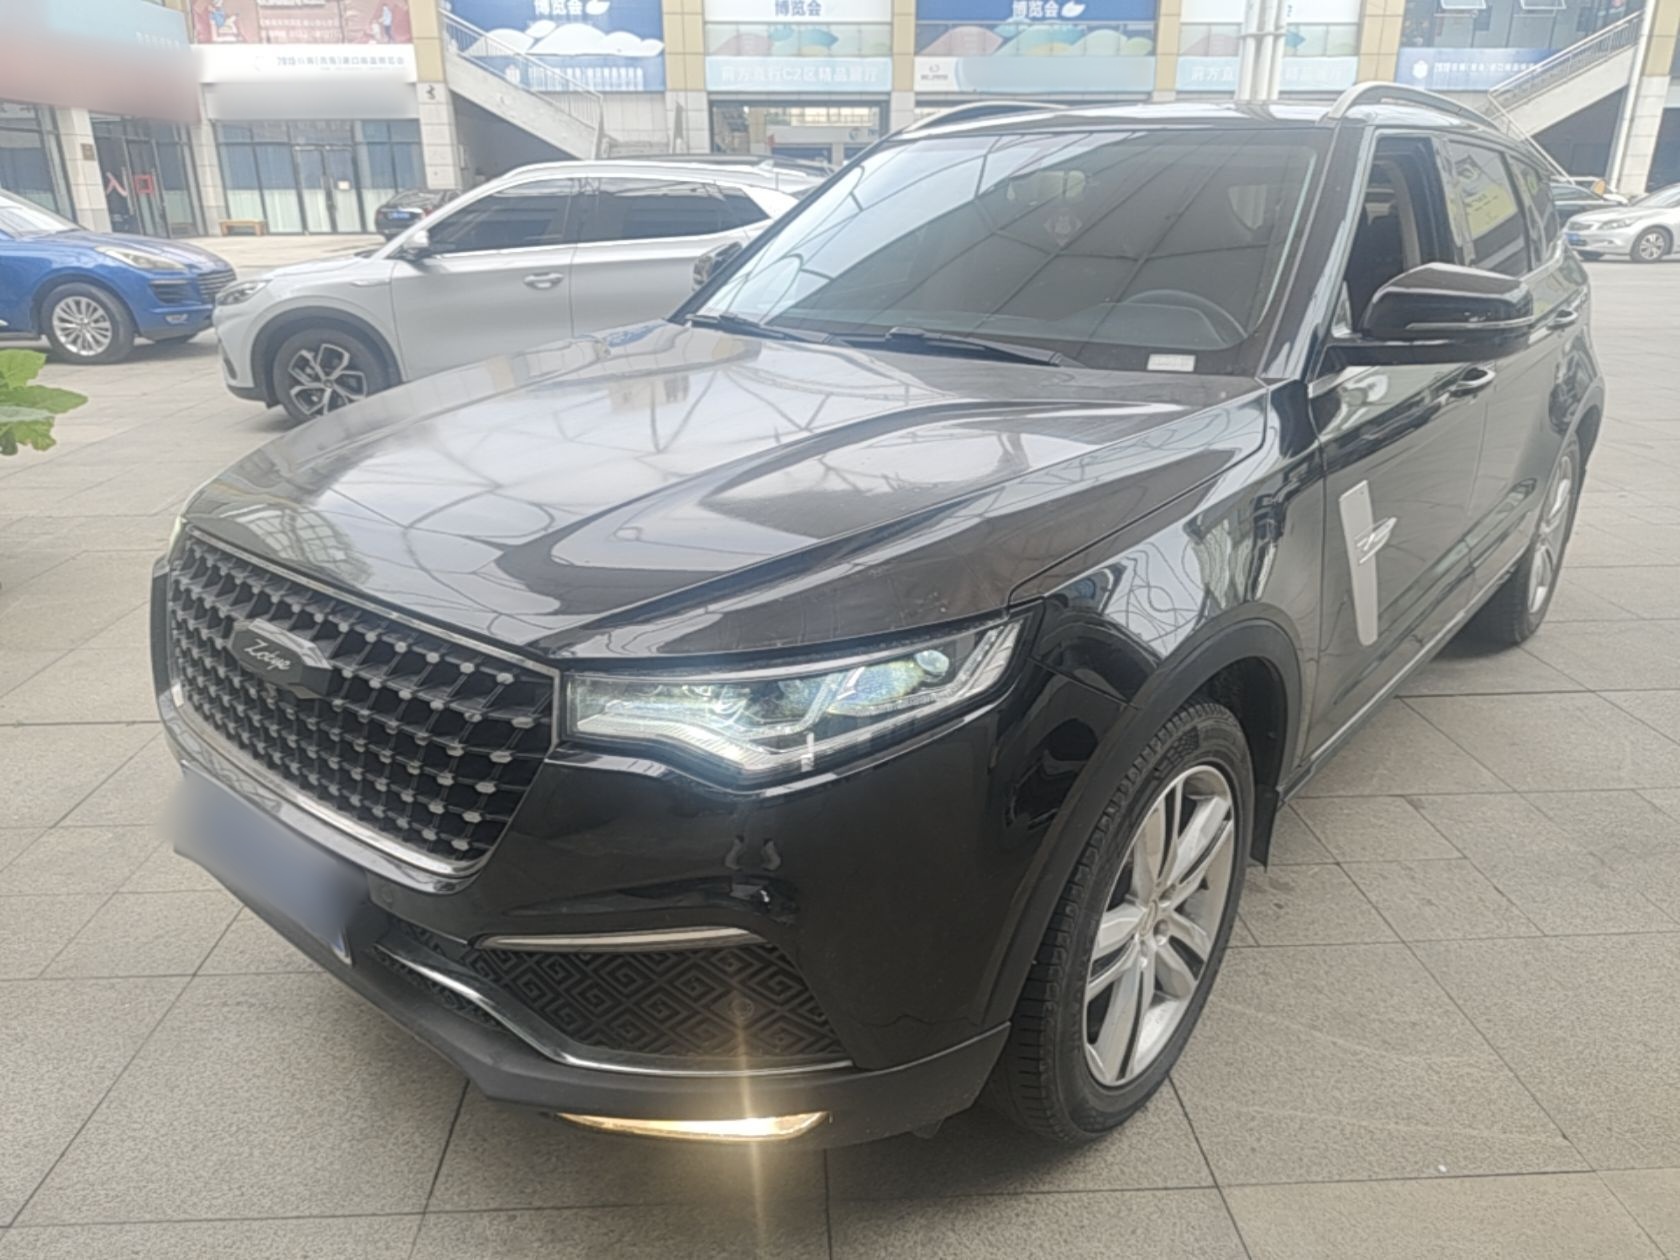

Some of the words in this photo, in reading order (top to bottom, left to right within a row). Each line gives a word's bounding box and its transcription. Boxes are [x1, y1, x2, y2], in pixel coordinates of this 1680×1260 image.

[775, 0, 822, 16] 博览会
[1012, 0, 1060, 18] 博览会
[105, 171, 154, 196] 入口
